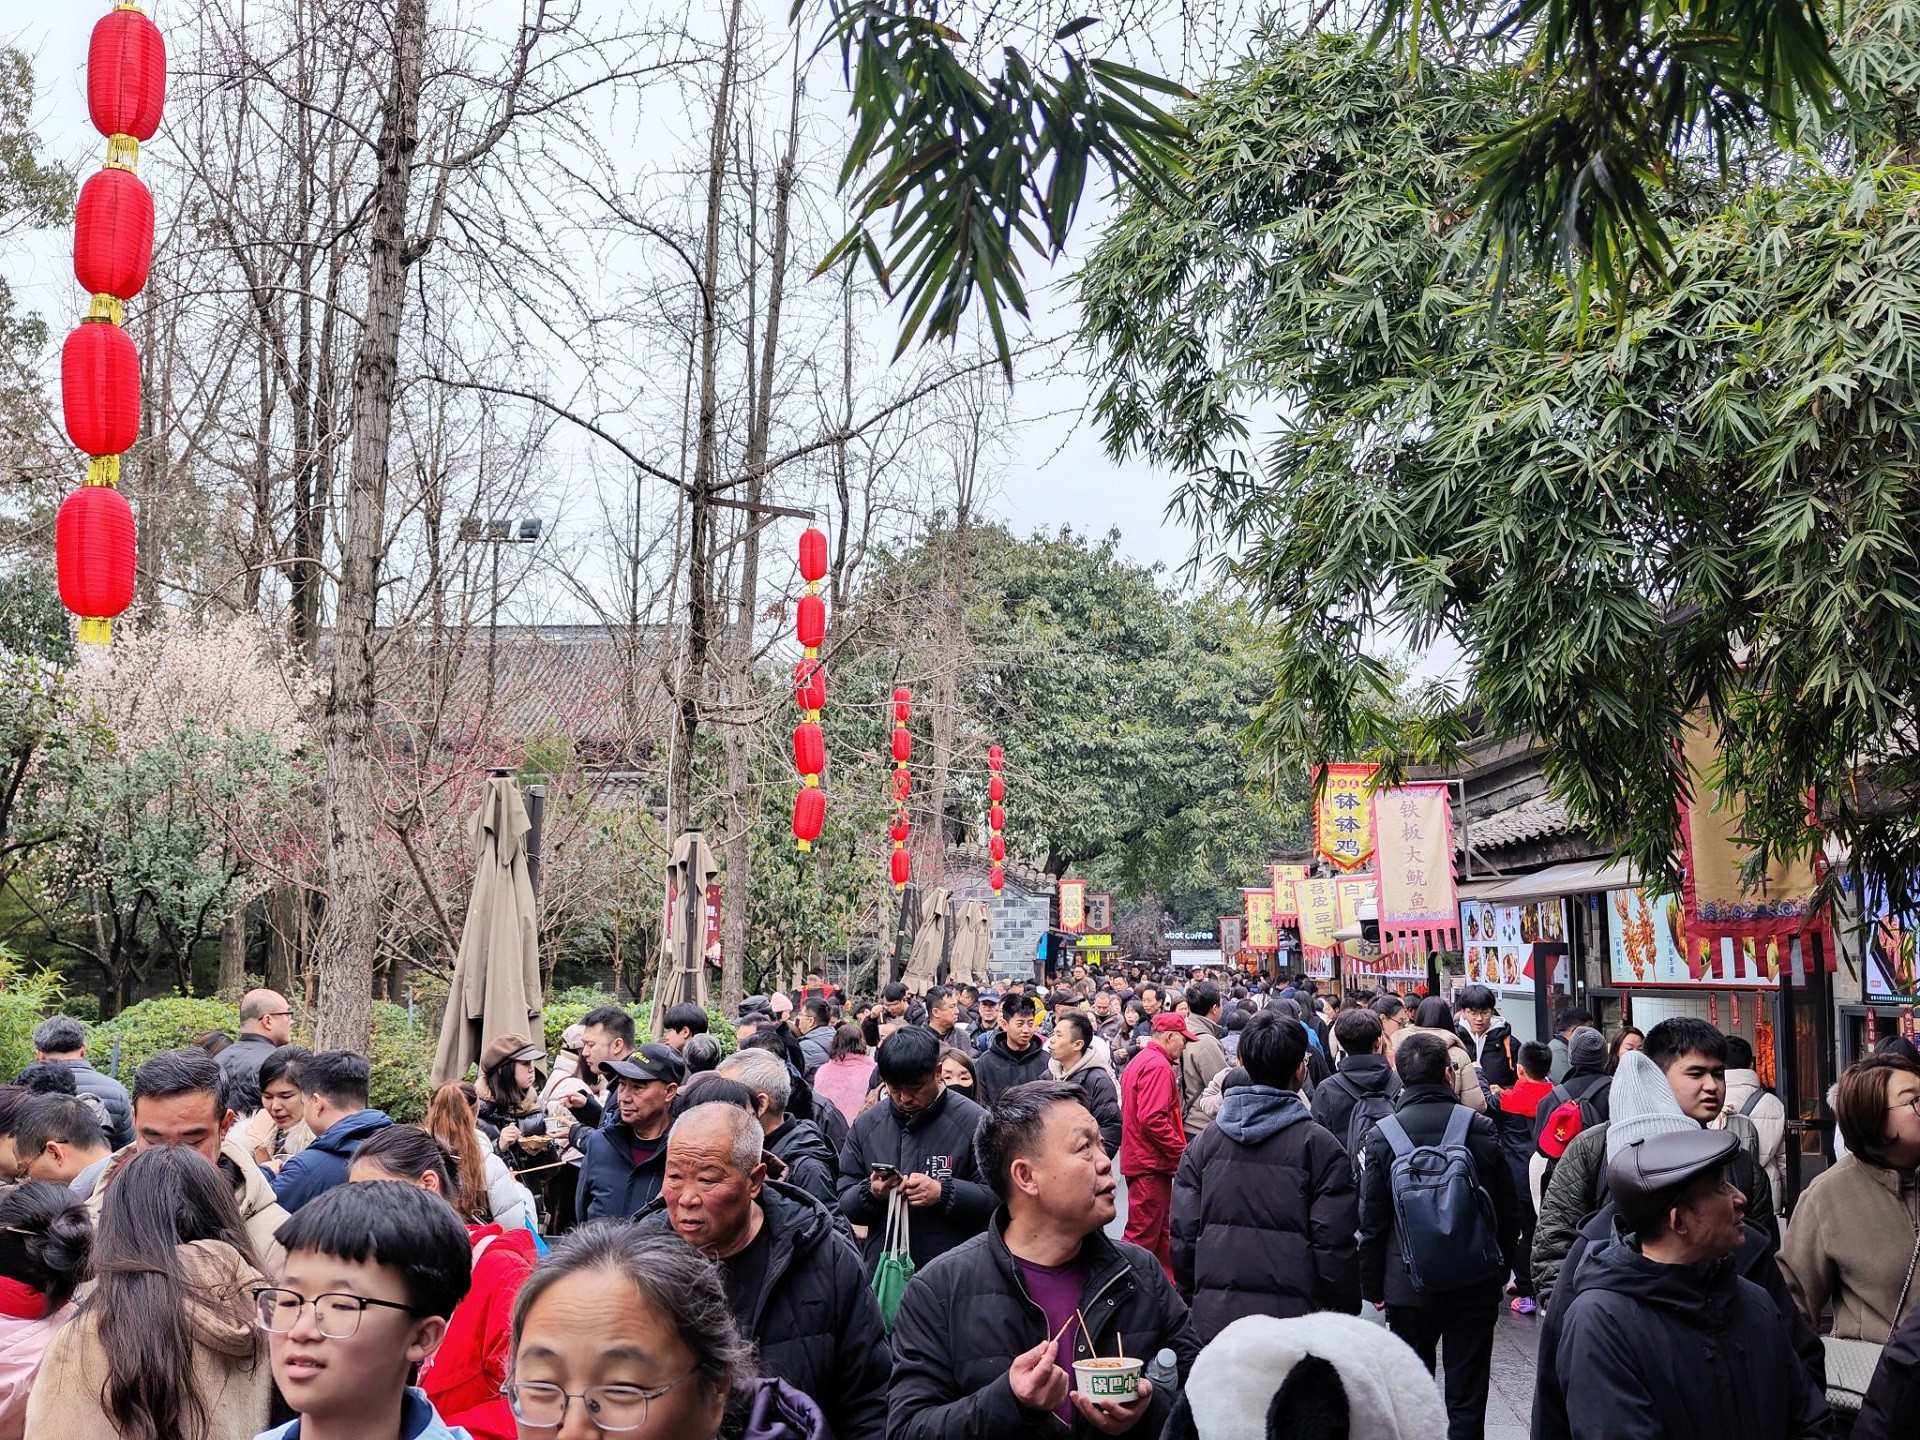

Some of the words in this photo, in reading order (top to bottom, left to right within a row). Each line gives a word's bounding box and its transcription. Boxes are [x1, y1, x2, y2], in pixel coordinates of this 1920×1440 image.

[1333, 792, 1361, 857] 钵钵鸡
[1399, 800, 1428, 911] 铁板大鱿鱼
[1185, 931, 1213, 940] coffee
[1309, 882, 1333, 937] 苕皮豆干
[937, 1155, 952, 1180] FIL
